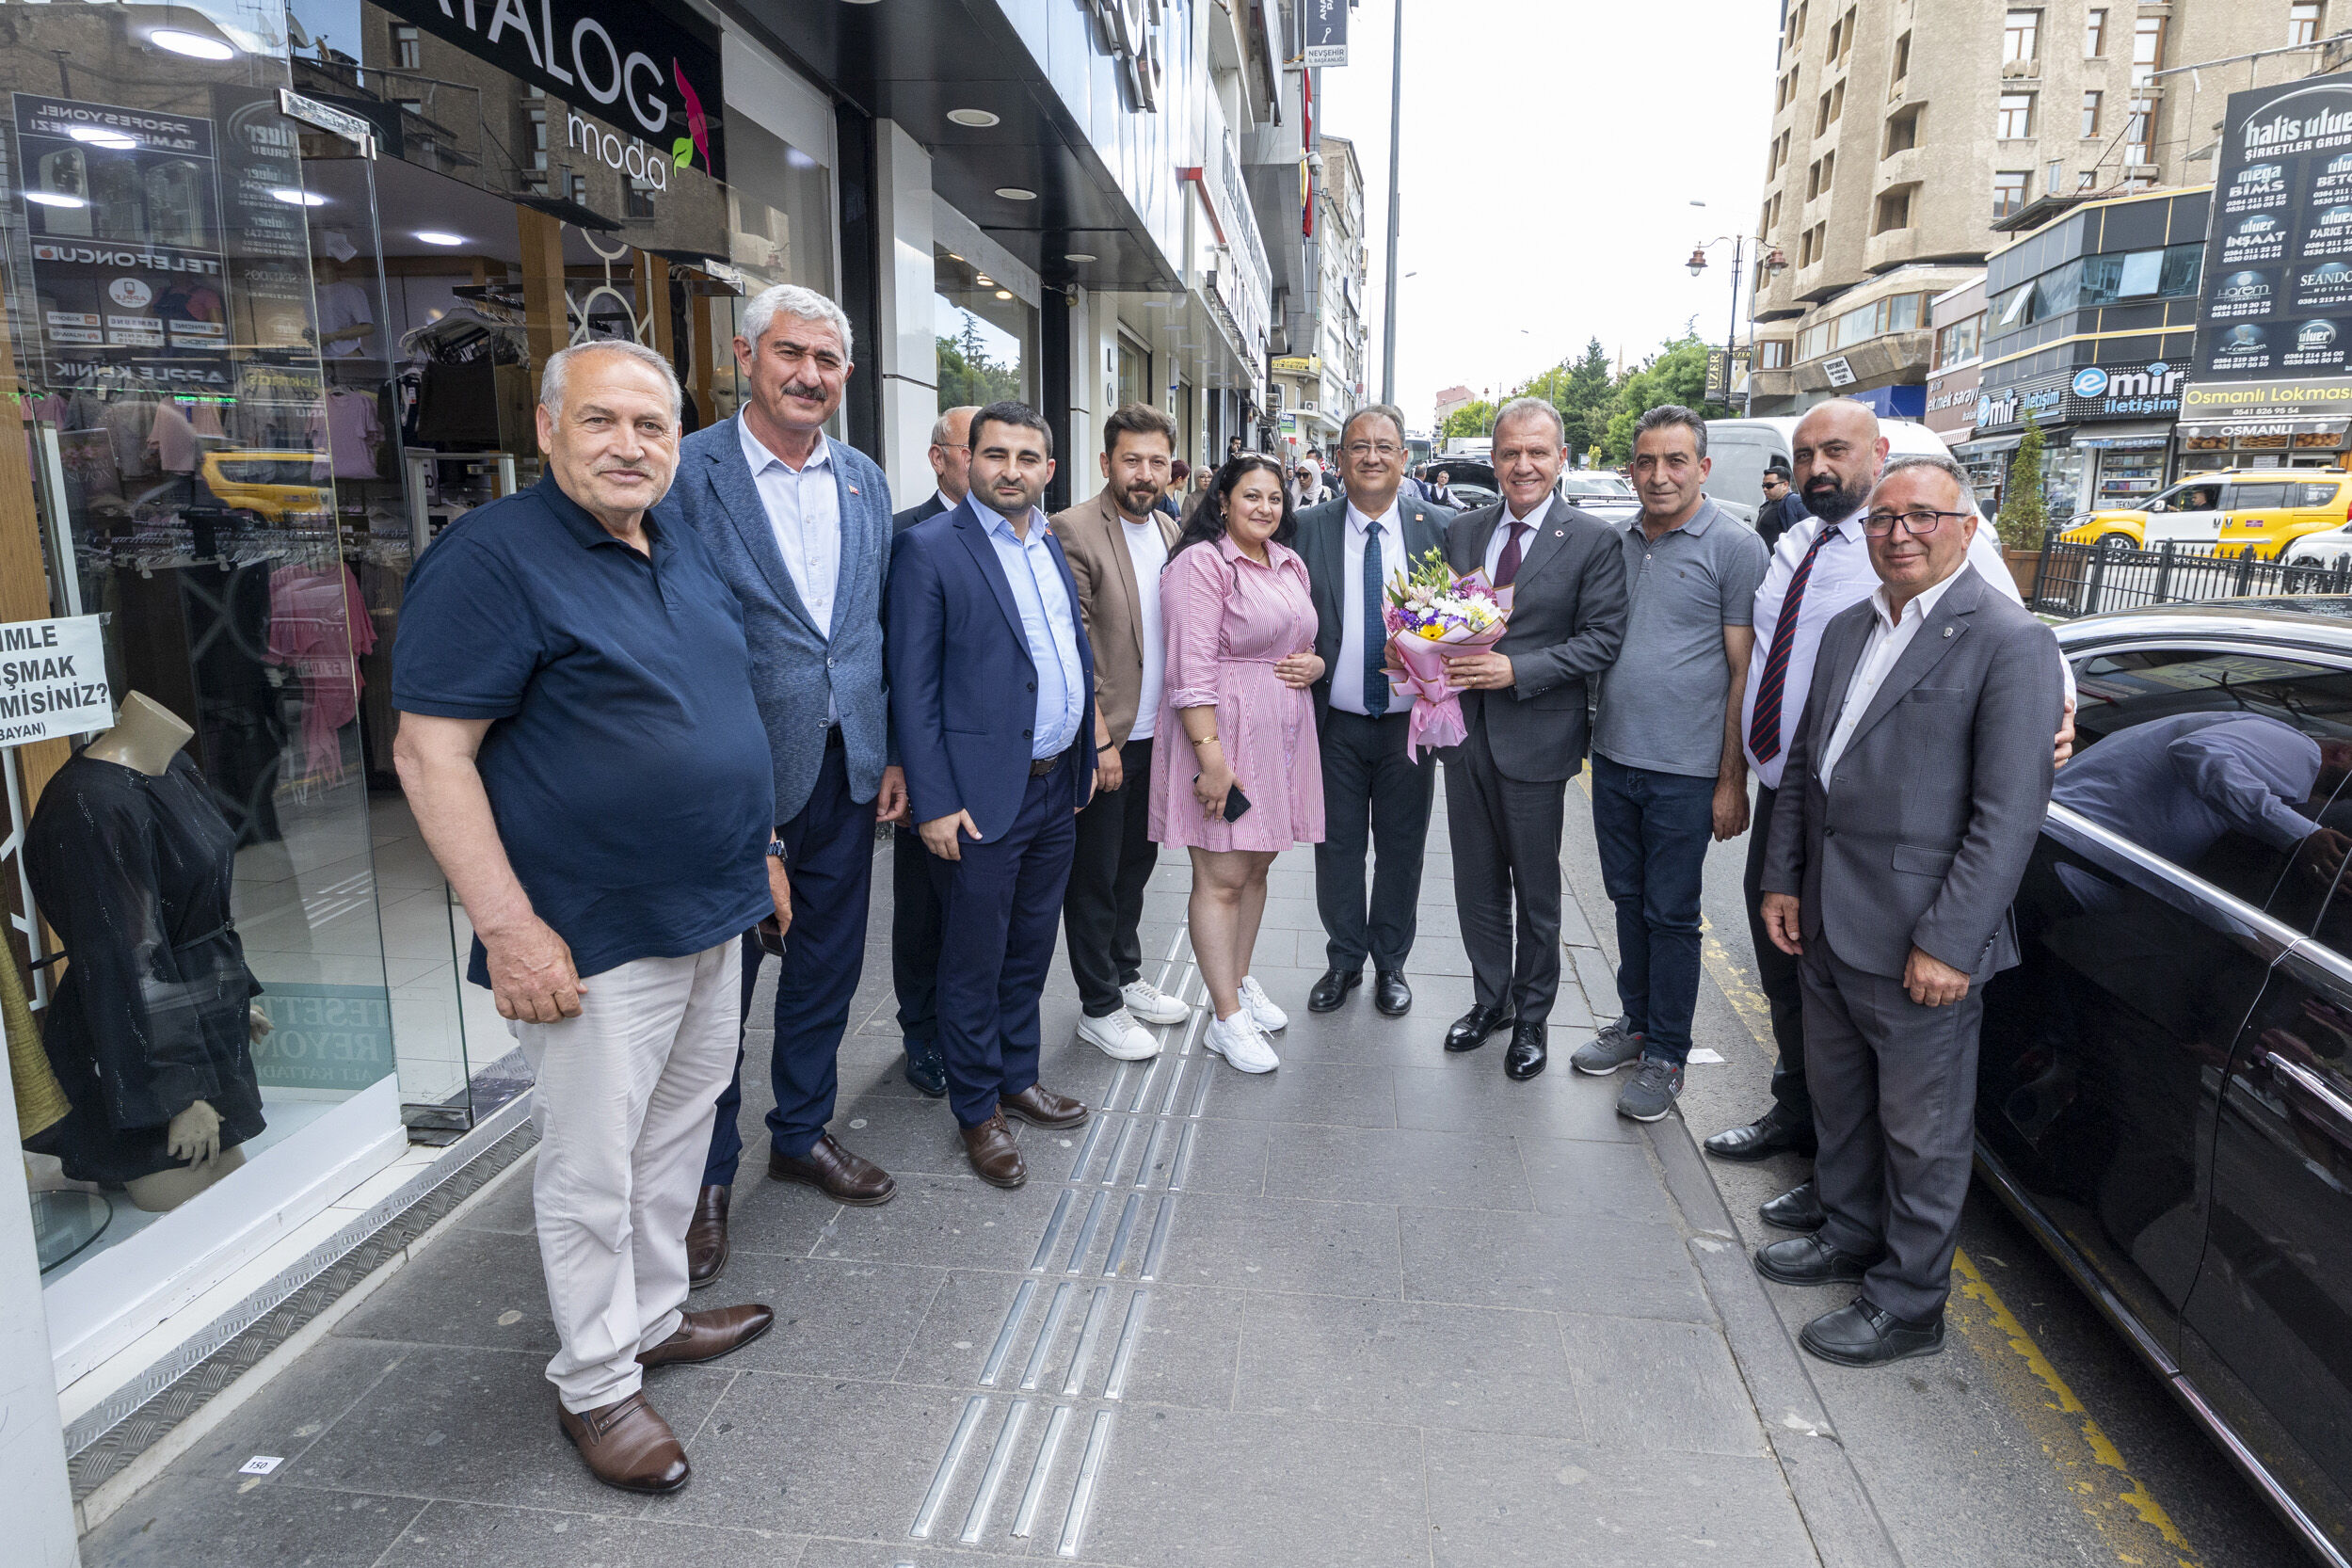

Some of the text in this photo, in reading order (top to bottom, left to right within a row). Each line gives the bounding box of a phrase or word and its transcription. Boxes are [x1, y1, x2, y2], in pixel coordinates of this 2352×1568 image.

[1308, 48, 1344, 57] NEVŞEHİR
[439, 0, 668, 133] ALOG
[2245, 114, 2301, 148] halis
[568, 112, 666, 192] moda
[2245, 140, 2312, 162] ŞİRKETLER
[2237, 165, 2282, 184] mega
[2240, 219, 2276, 233] uluer
[2310, 225, 2344, 239] PARKE
[2216, 284, 2269, 297] Harem
[2313, 285, 2345, 294] HOTEL
[2298, 329, 2330, 342] uluer
[1707, 353, 1720, 390] UZER
[2072, 361, 2184, 398] emir
[1927, 385, 1980, 412] ekmek sarayı
[2104, 397, 2178, 414] iletişim
[2186, 388, 2265, 405] Osmanlı
[1976, 388, 2060, 427] emir iletişim
[2220, 424, 2294, 436] OSMANLI
[1, 682, 108, 719] MİSİNİZ?
[248, 1461, 268, 1470] 150
